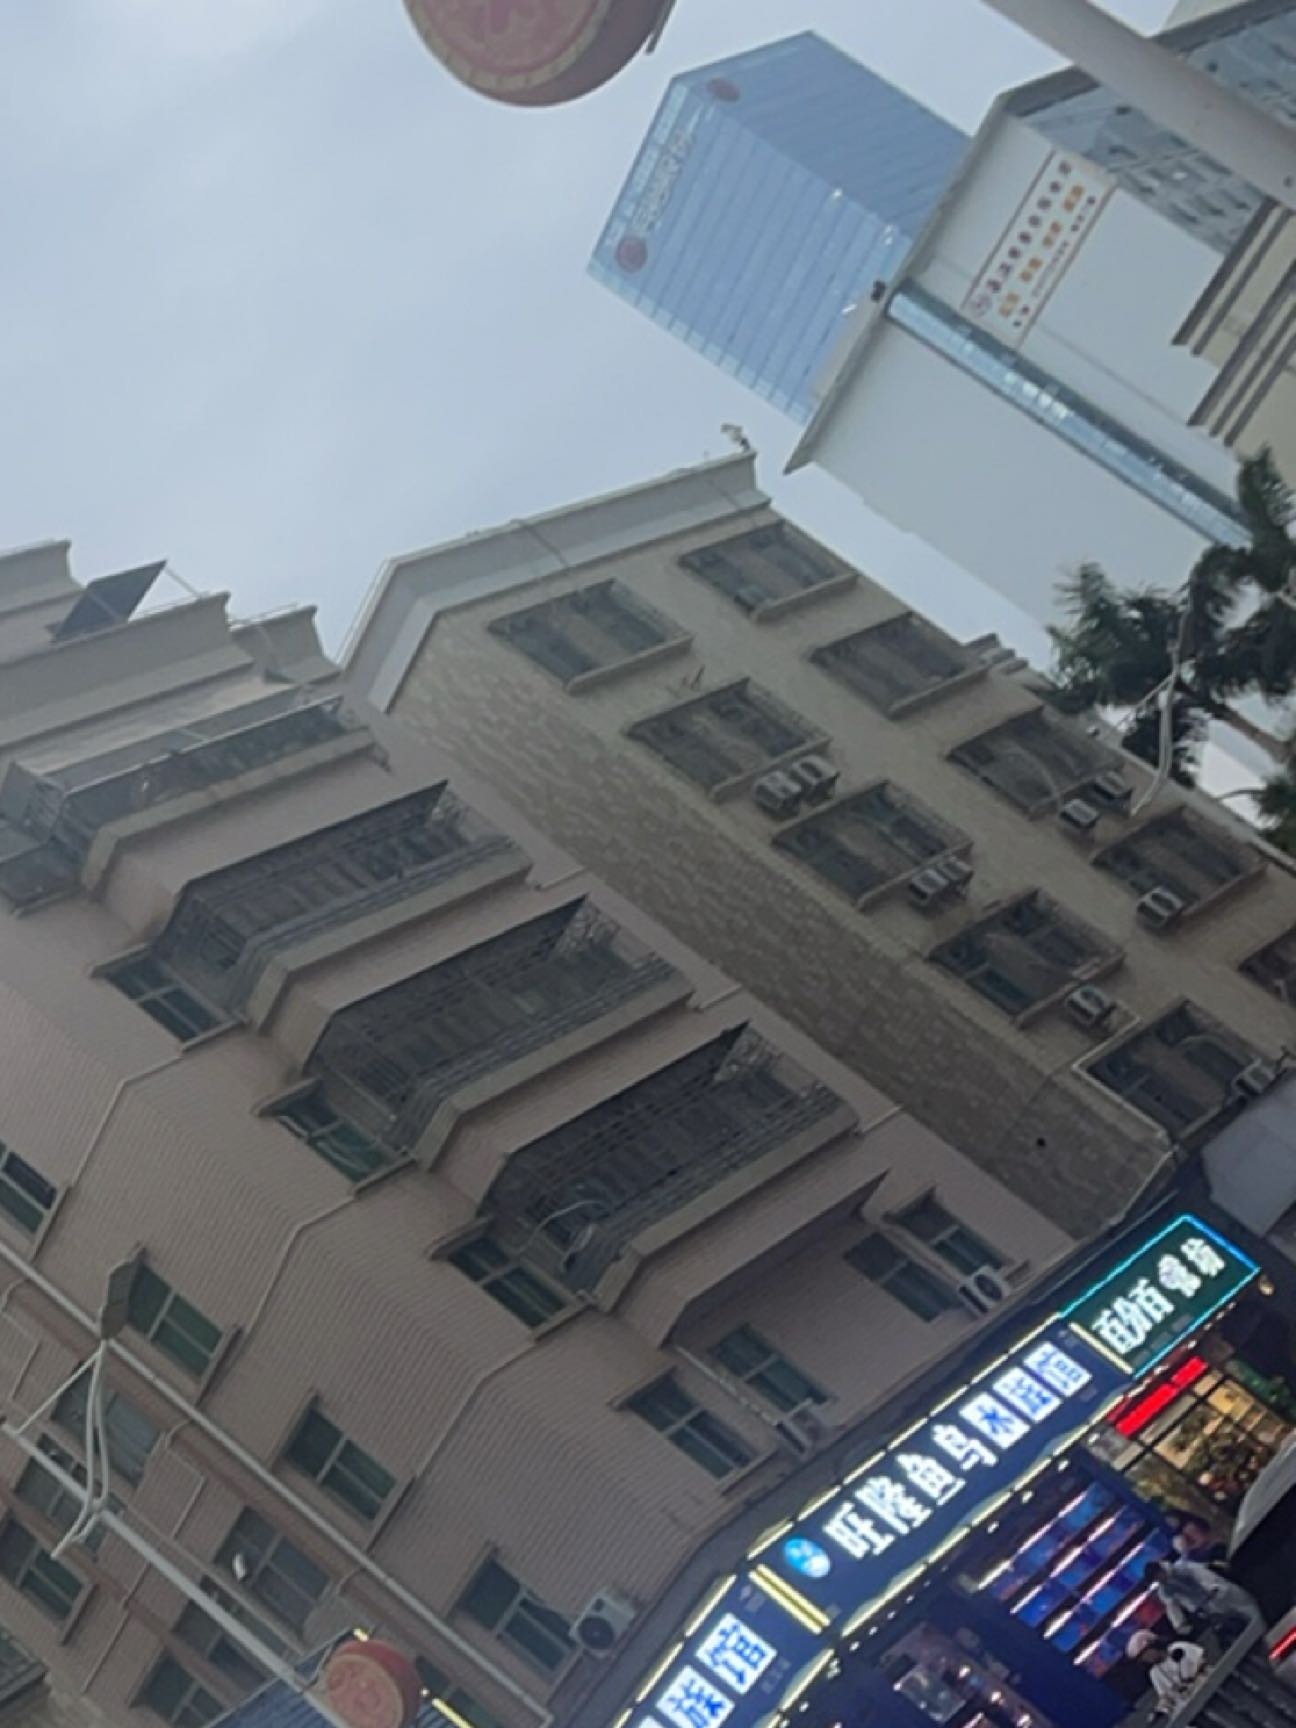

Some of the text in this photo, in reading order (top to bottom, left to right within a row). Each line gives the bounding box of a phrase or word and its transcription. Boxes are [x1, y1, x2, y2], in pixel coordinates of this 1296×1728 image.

[823, 1341, 1093, 1559] 旺隆鱼鸟水族馆
